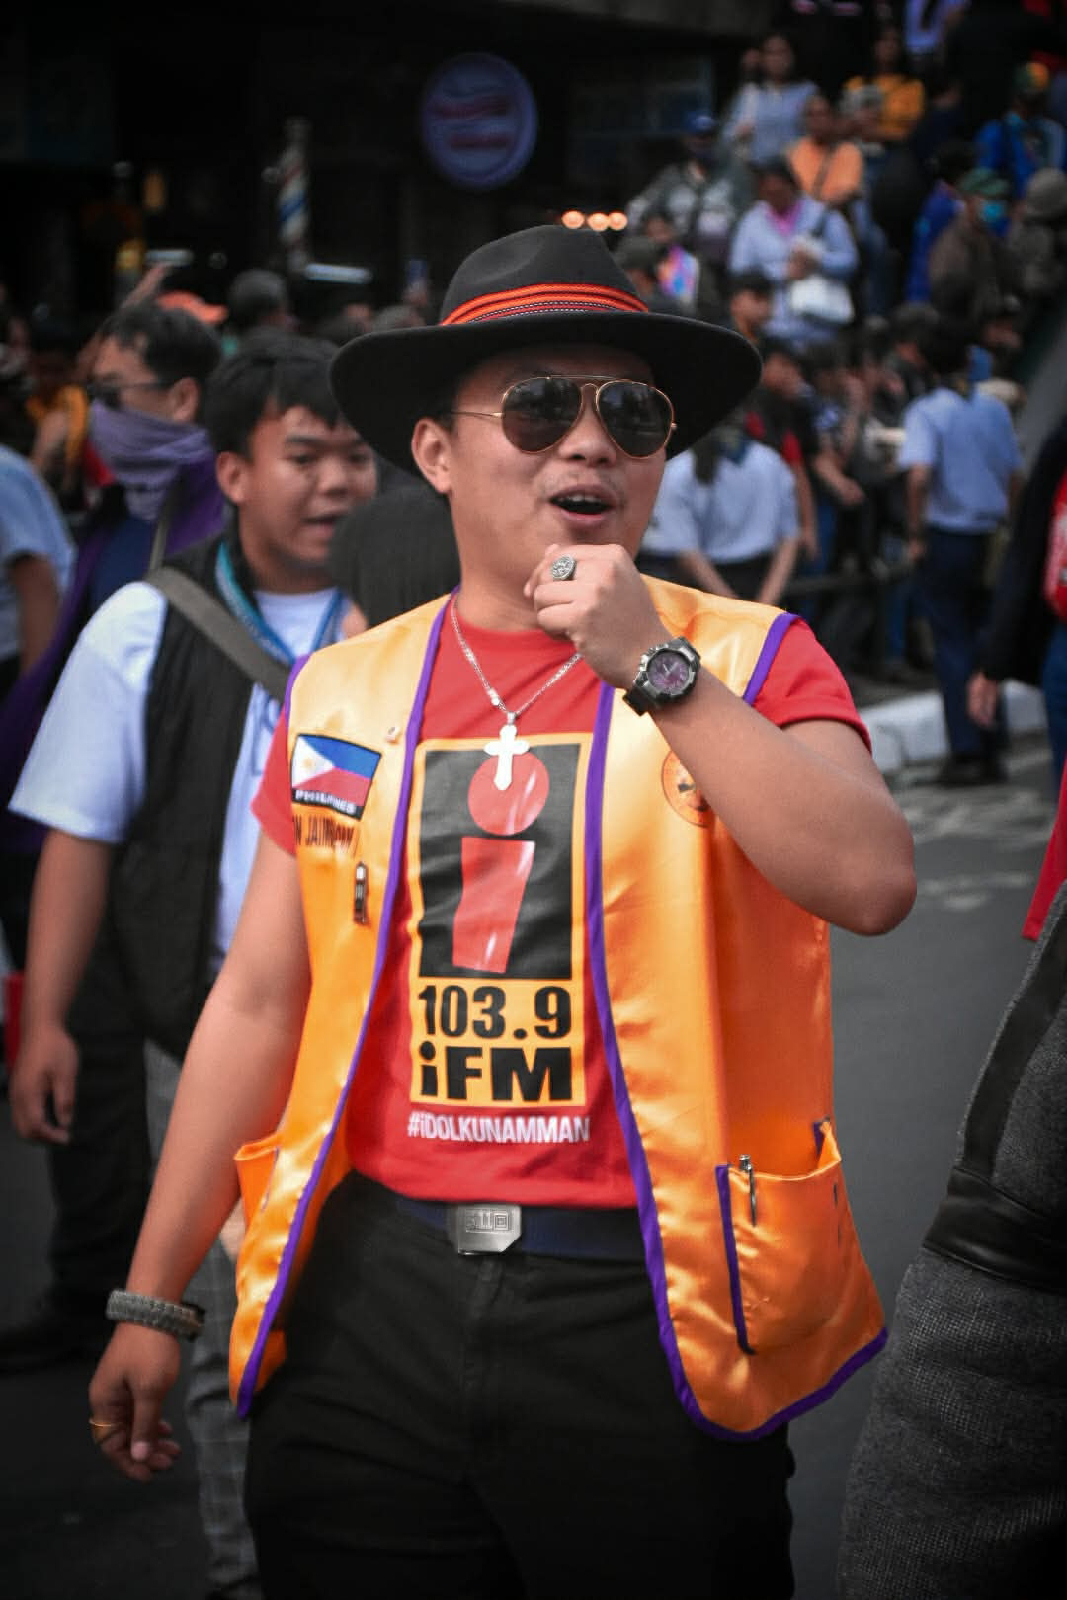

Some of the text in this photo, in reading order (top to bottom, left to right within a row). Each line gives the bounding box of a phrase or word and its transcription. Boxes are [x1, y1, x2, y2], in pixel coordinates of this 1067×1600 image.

[419, 985, 572, 1040] 103.9
[419, 1040, 573, 1102] iFM
[408, 1110, 590, 1143] #iDOLKUNAMMAN
